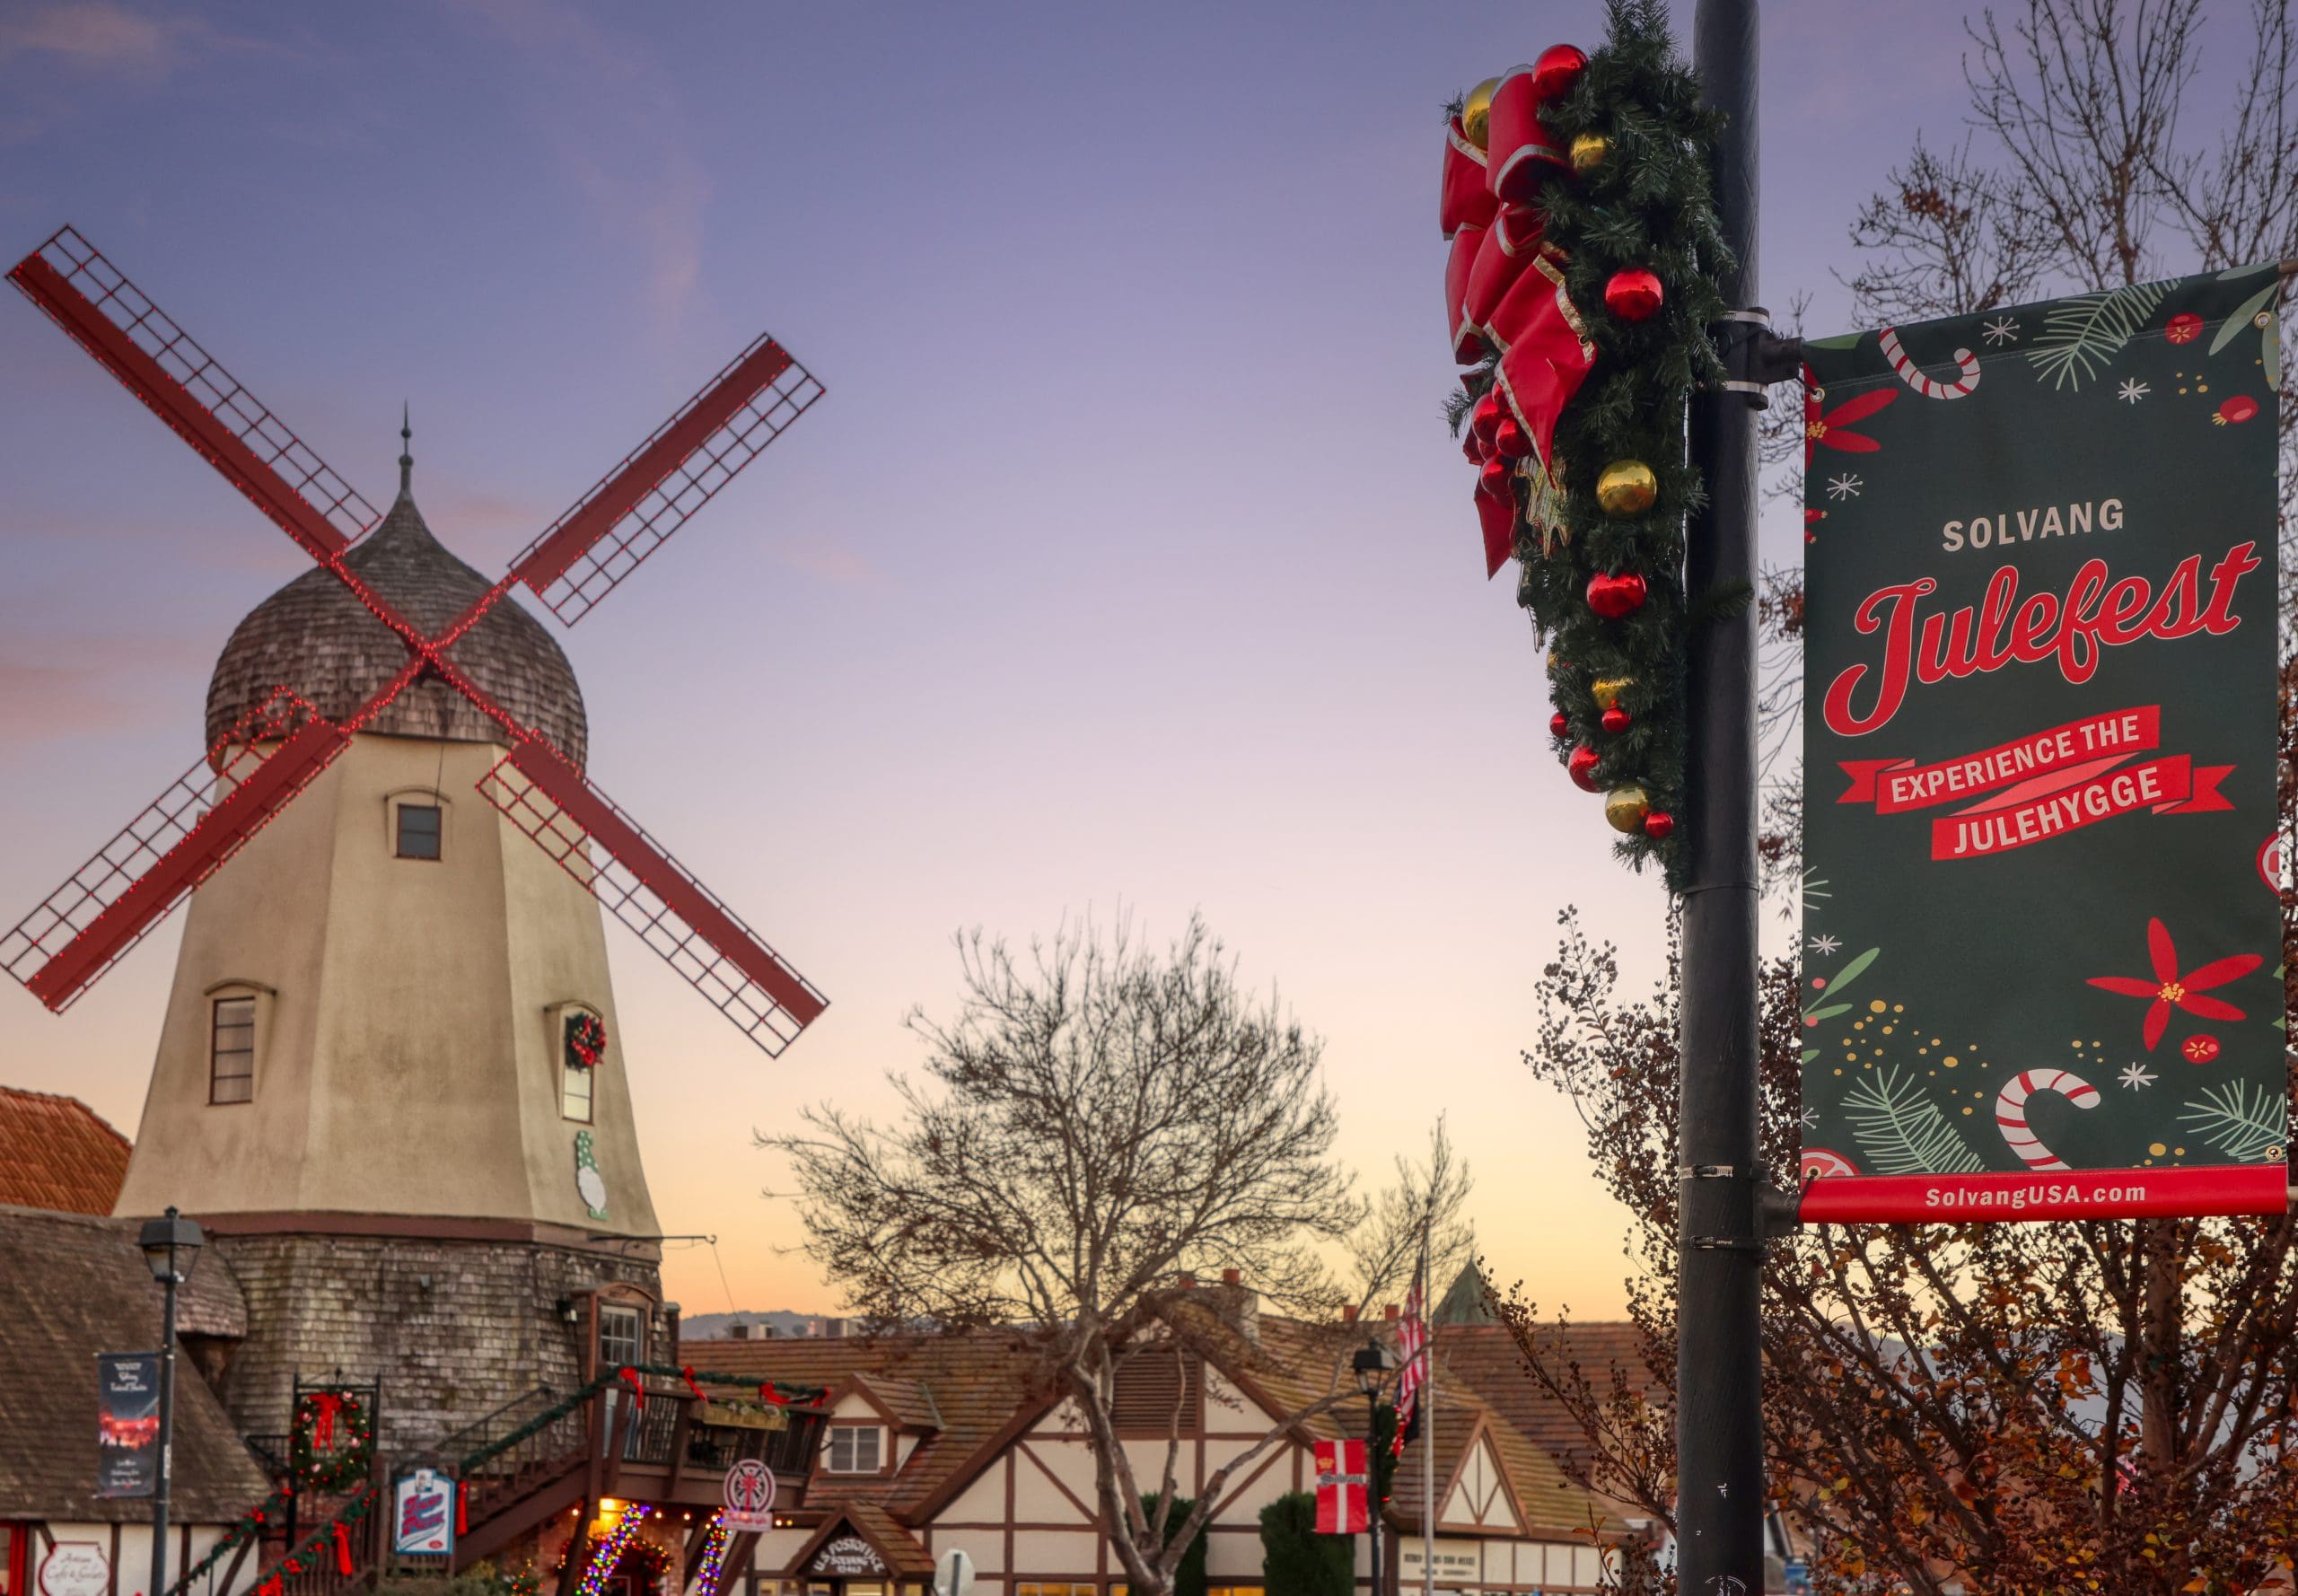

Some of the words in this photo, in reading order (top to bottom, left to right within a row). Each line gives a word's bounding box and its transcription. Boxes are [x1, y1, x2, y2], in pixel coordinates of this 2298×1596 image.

[1943, 498, 2124, 552] SOLVANG
[1823, 541, 2261, 736] Julefest
[1891, 731, 2074, 803] EXPERIENCE
[2079, 715, 2140, 750] THE
[1954, 767, 2162, 854] JULEHYGGE
[1925, 1185, 2145, 1209] SolvangUSA.com
